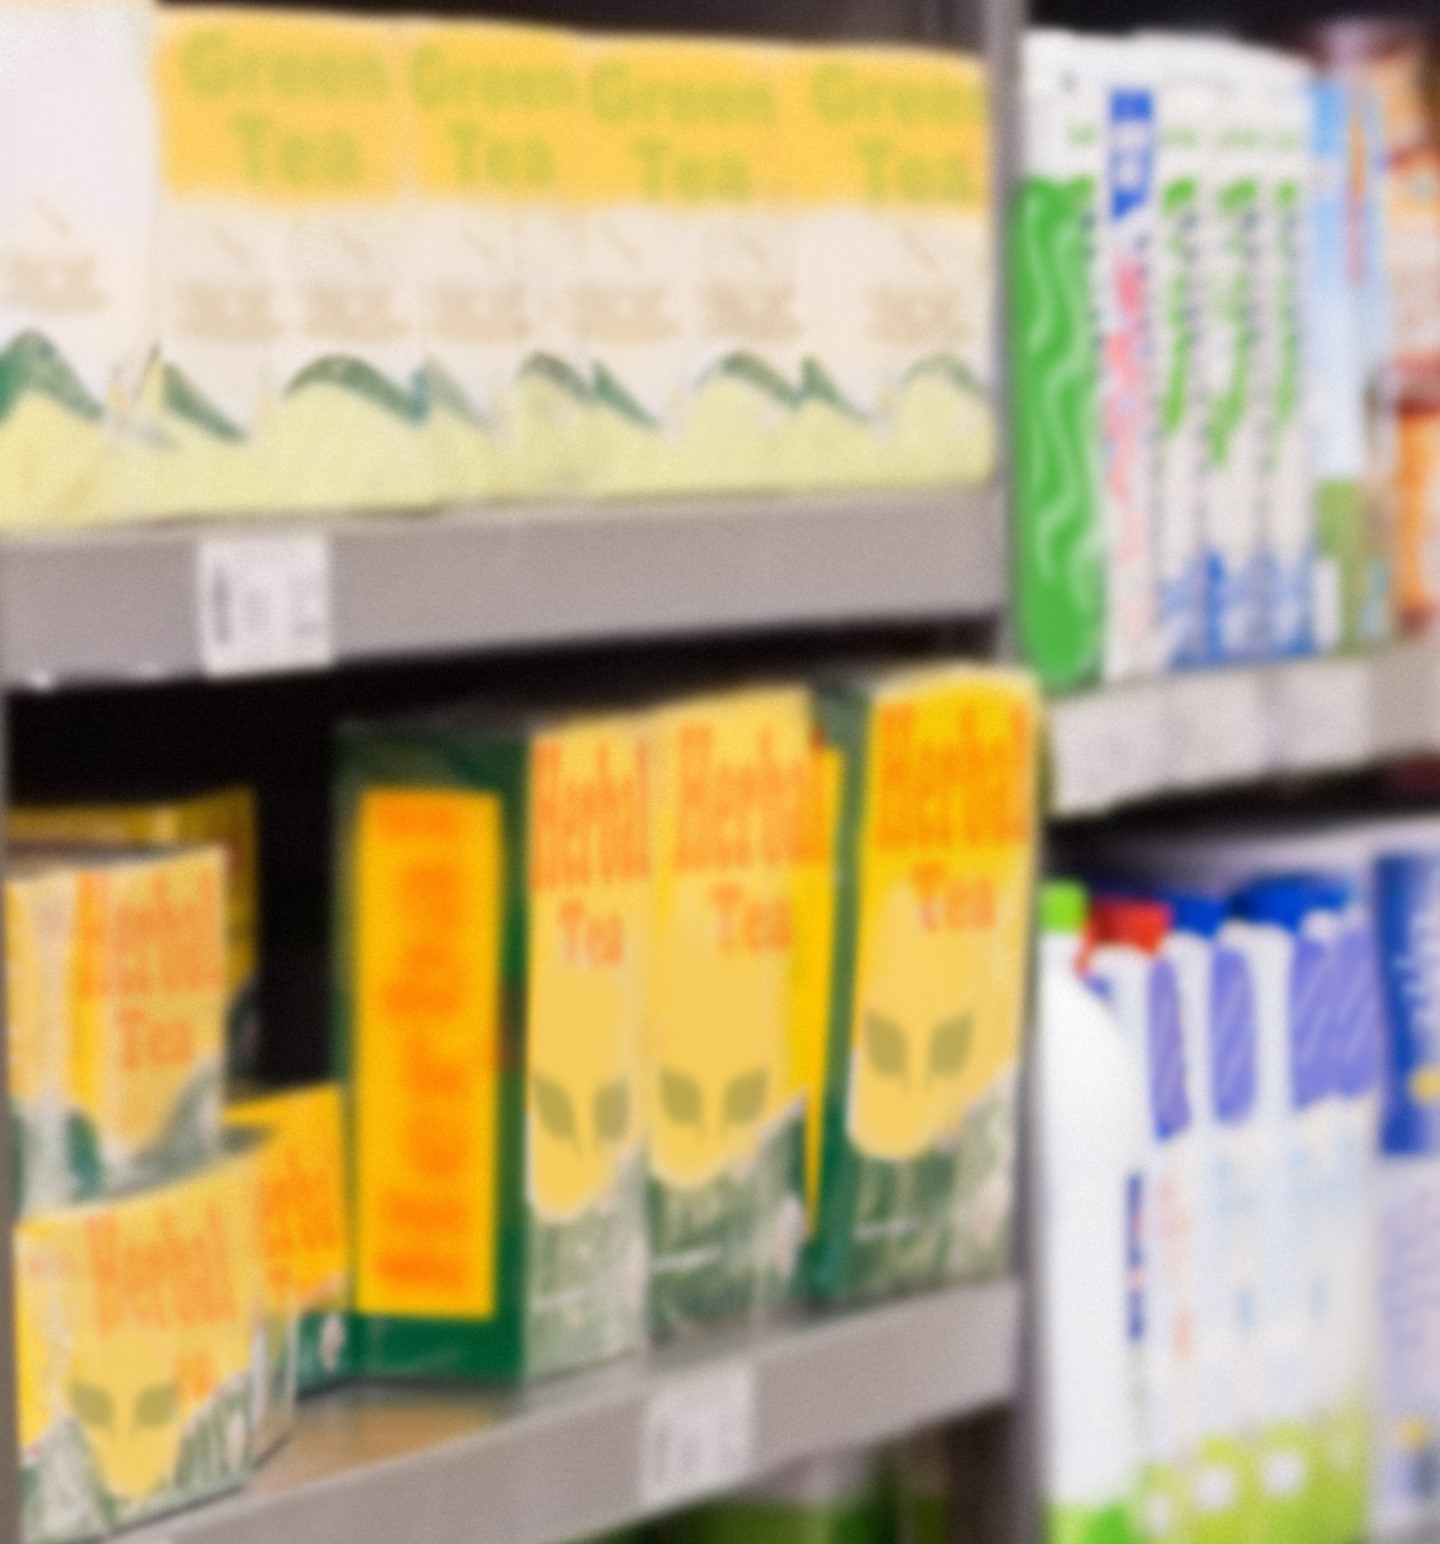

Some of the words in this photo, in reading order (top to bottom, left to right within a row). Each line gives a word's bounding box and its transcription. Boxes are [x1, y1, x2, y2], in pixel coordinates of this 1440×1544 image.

[180, 27, 390, 99] Green
[409, 42, 577, 109] Green
[589, 61, 777, 125] Green
[811, 64, 982, 127] Gree
[231, 109, 362, 187] Tea
[448, 121, 557, 190] Tea
[632, 138, 752, 205] Tea
[854, 136, 978, 206] Tea
[676, 719, 830, 870] Herbal
[879, 703, 1029, 848] Herbal
[533, 735, 649, 889] Herbal
[710, 881, 795, 954] Tea
[913, 861, 998, 932] Tea
[78, 869, 222, 1000] Herbal
[558, 900, 626, 967] Tea
[116, 1005, 193, 1070] Tea
[85, 1201, 237, 1339] Herbal
